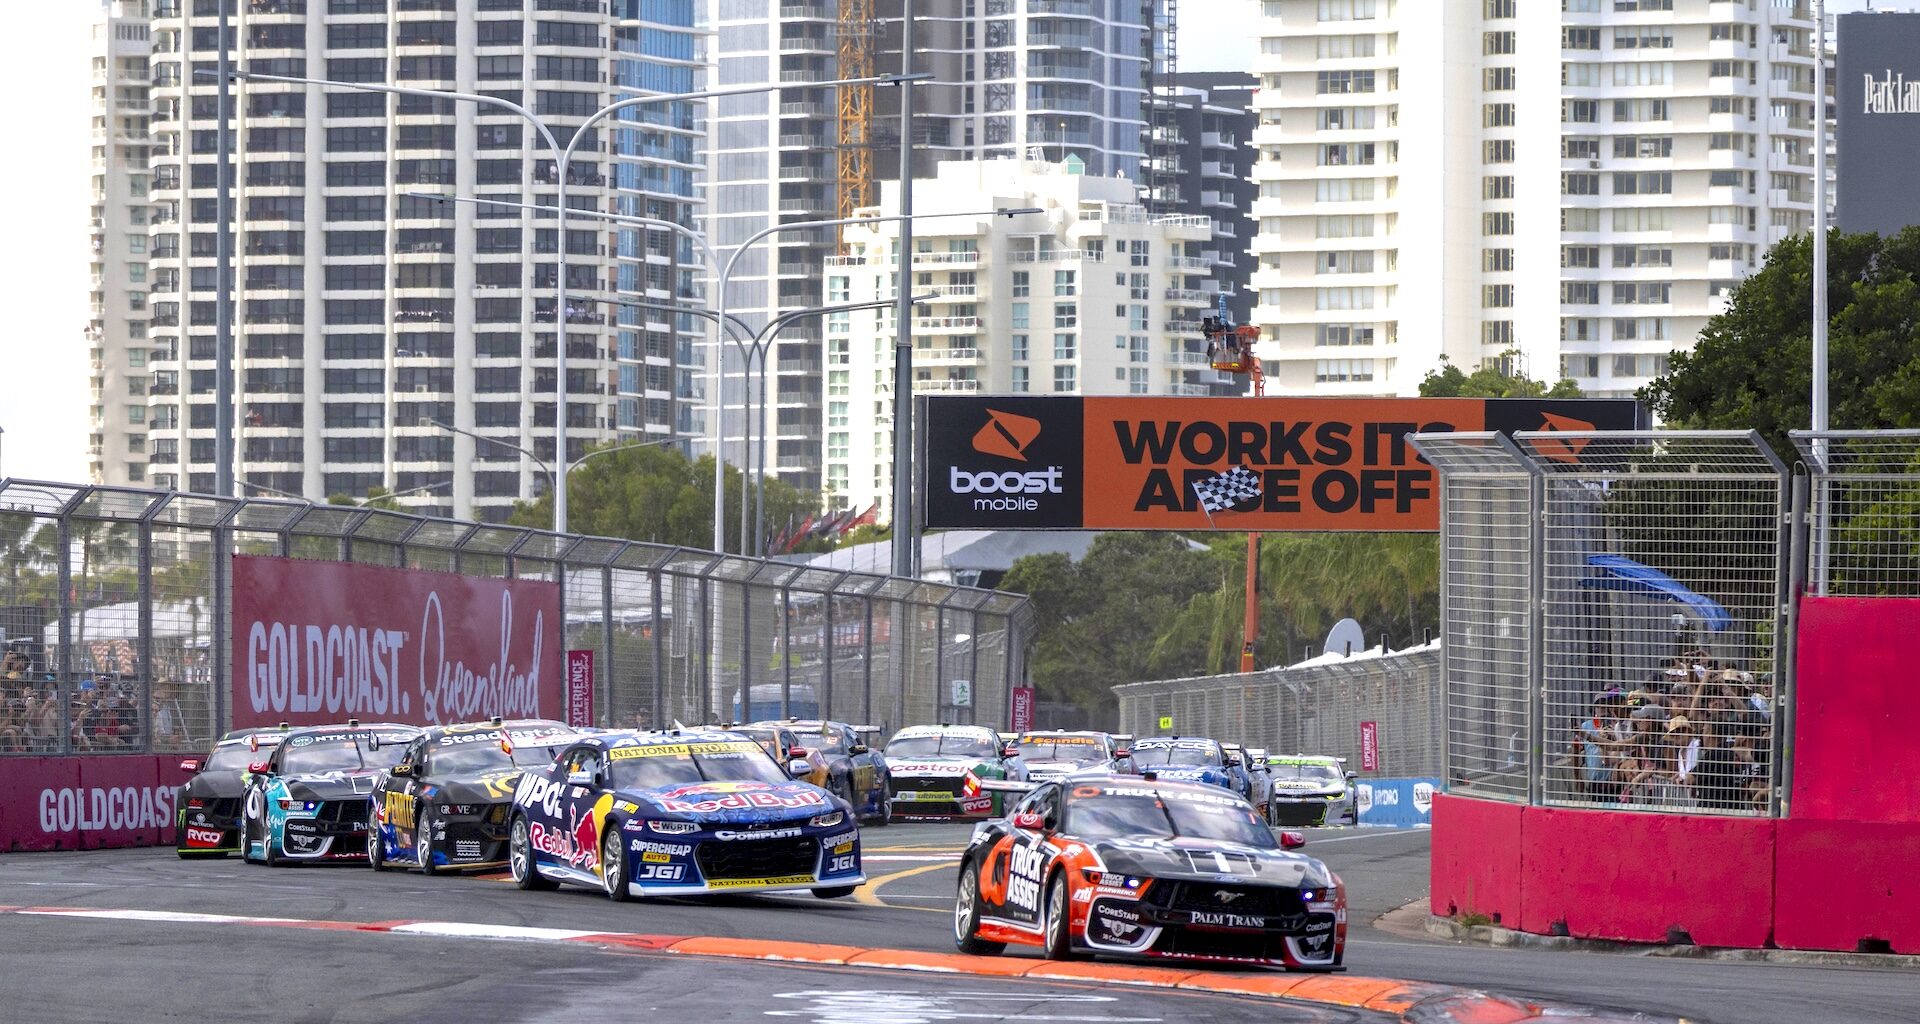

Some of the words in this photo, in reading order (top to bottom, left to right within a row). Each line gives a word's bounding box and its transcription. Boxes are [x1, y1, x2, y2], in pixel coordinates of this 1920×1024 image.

[1864, 69, 1897, 114] Park
[1113, 421, 1352, 466] WORKS
[951, 466, 1063, 493] boost
[1312, 469, 1432, 513] OFF
[974, 497, 1038, 511] mobile
[420, 589, 543, 726] Queensland
[1015, 693, 1025, 732] ERIENCE
[440, 727, 544, 746] Steadast
[612, 745, 686, 759] NATIONAL
[1104, 787, 1174, 799] TRUCK
[40, 785, 179, 833] GOLDCOAST
[440, 805, 470, 815] GROVE
[661, 793, 749, 813] Red
[748, 791, 825, 808] Bull
[963, 799, 991, 811] RYCO
[187, 828, 220, 843] RYCO
[631, 839, 691, 857] SUPERCHEAP
[828, 856, 855, 872] JGI
[1010, 843, 1045, 882] TRUCK
[640, 865, 683, 879] JGI
[1101, 873, 1125, 881] TRUCK
[710, 879, 764, 888] NATIONAL
[1096, 887, 1136, 896] GEARWRENCH
[1007, 873, 1040, 912] ASSIST
[1190, 911, 1223, 924] PALM
[1226, 913, 1265, 927] TRANS
